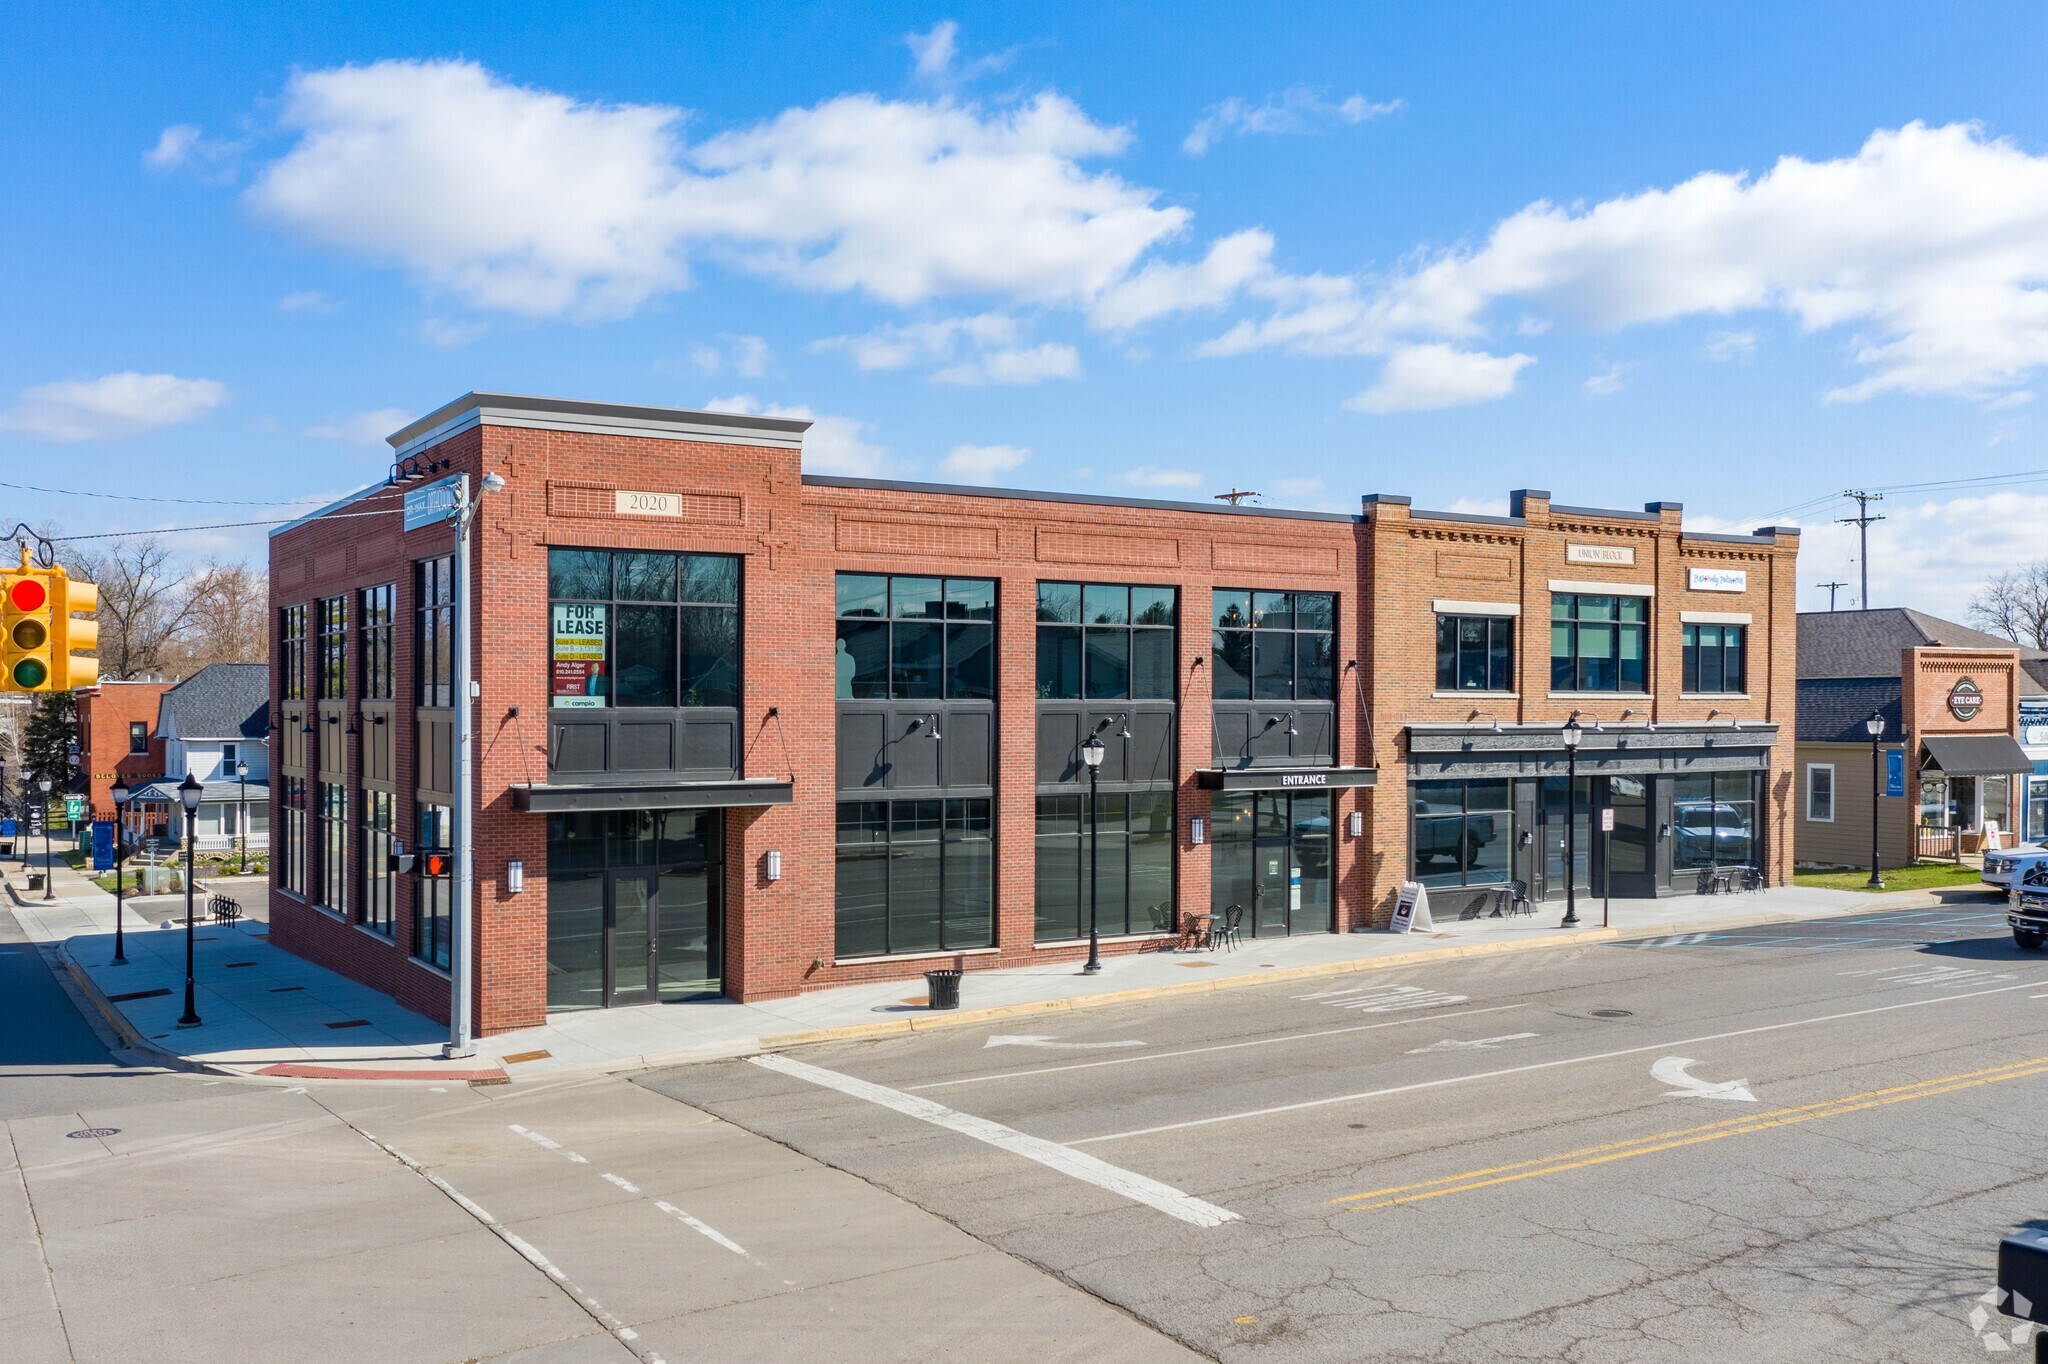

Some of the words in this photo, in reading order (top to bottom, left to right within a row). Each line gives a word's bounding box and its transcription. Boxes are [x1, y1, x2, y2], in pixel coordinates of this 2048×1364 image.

[630, 494, 667, 511] 2020
[1578, 548, 1600, 559] UNION
[1602, 550, 1622, 560] BLOCK
[566, 604, 594, 619] FOR
[557, 620, 604, 634] LEASE
[1282, 774, 1326, 786] ENTRANCE
